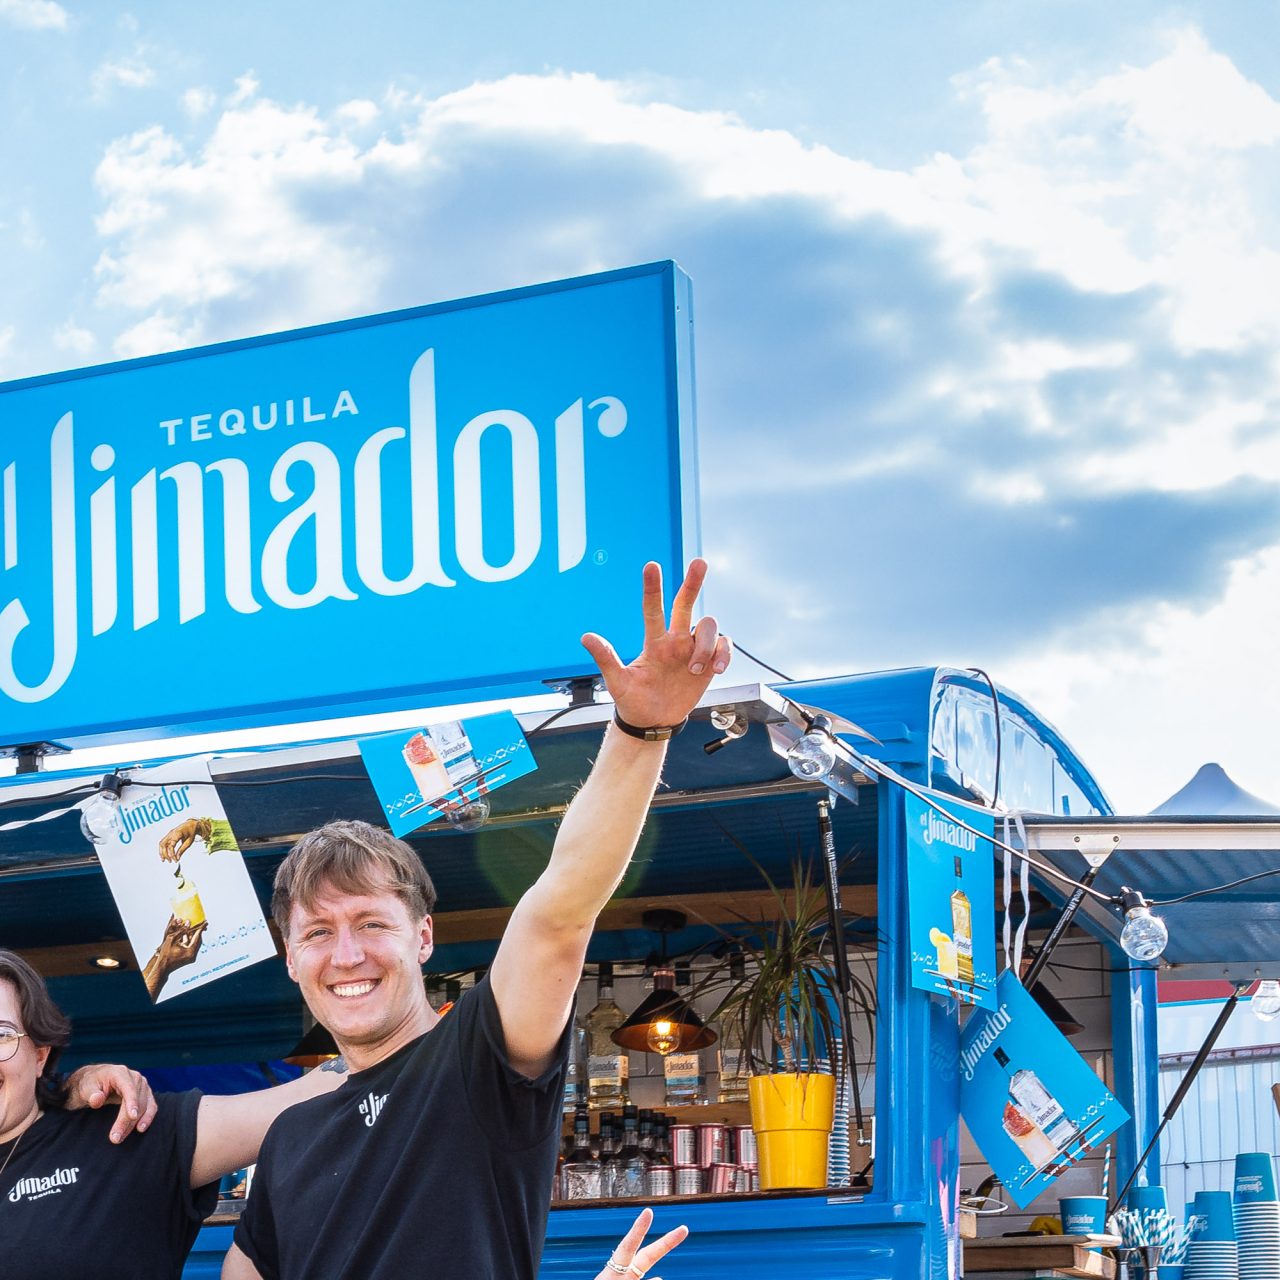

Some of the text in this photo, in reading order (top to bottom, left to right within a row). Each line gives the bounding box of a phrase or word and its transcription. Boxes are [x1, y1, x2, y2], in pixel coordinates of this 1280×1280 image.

[159, 390, 359, 446] TEQUILA
[118, 785, 190, 845] Jimador
[923, 808, 979, 852] Jimador
[961, 1004, 1012, 1081] Jimador
[359, 1099, 369, 1114] el
[8, 1167, 80, 1202] Jimador
[27, 1188, 62, 1201] TEQUILA
